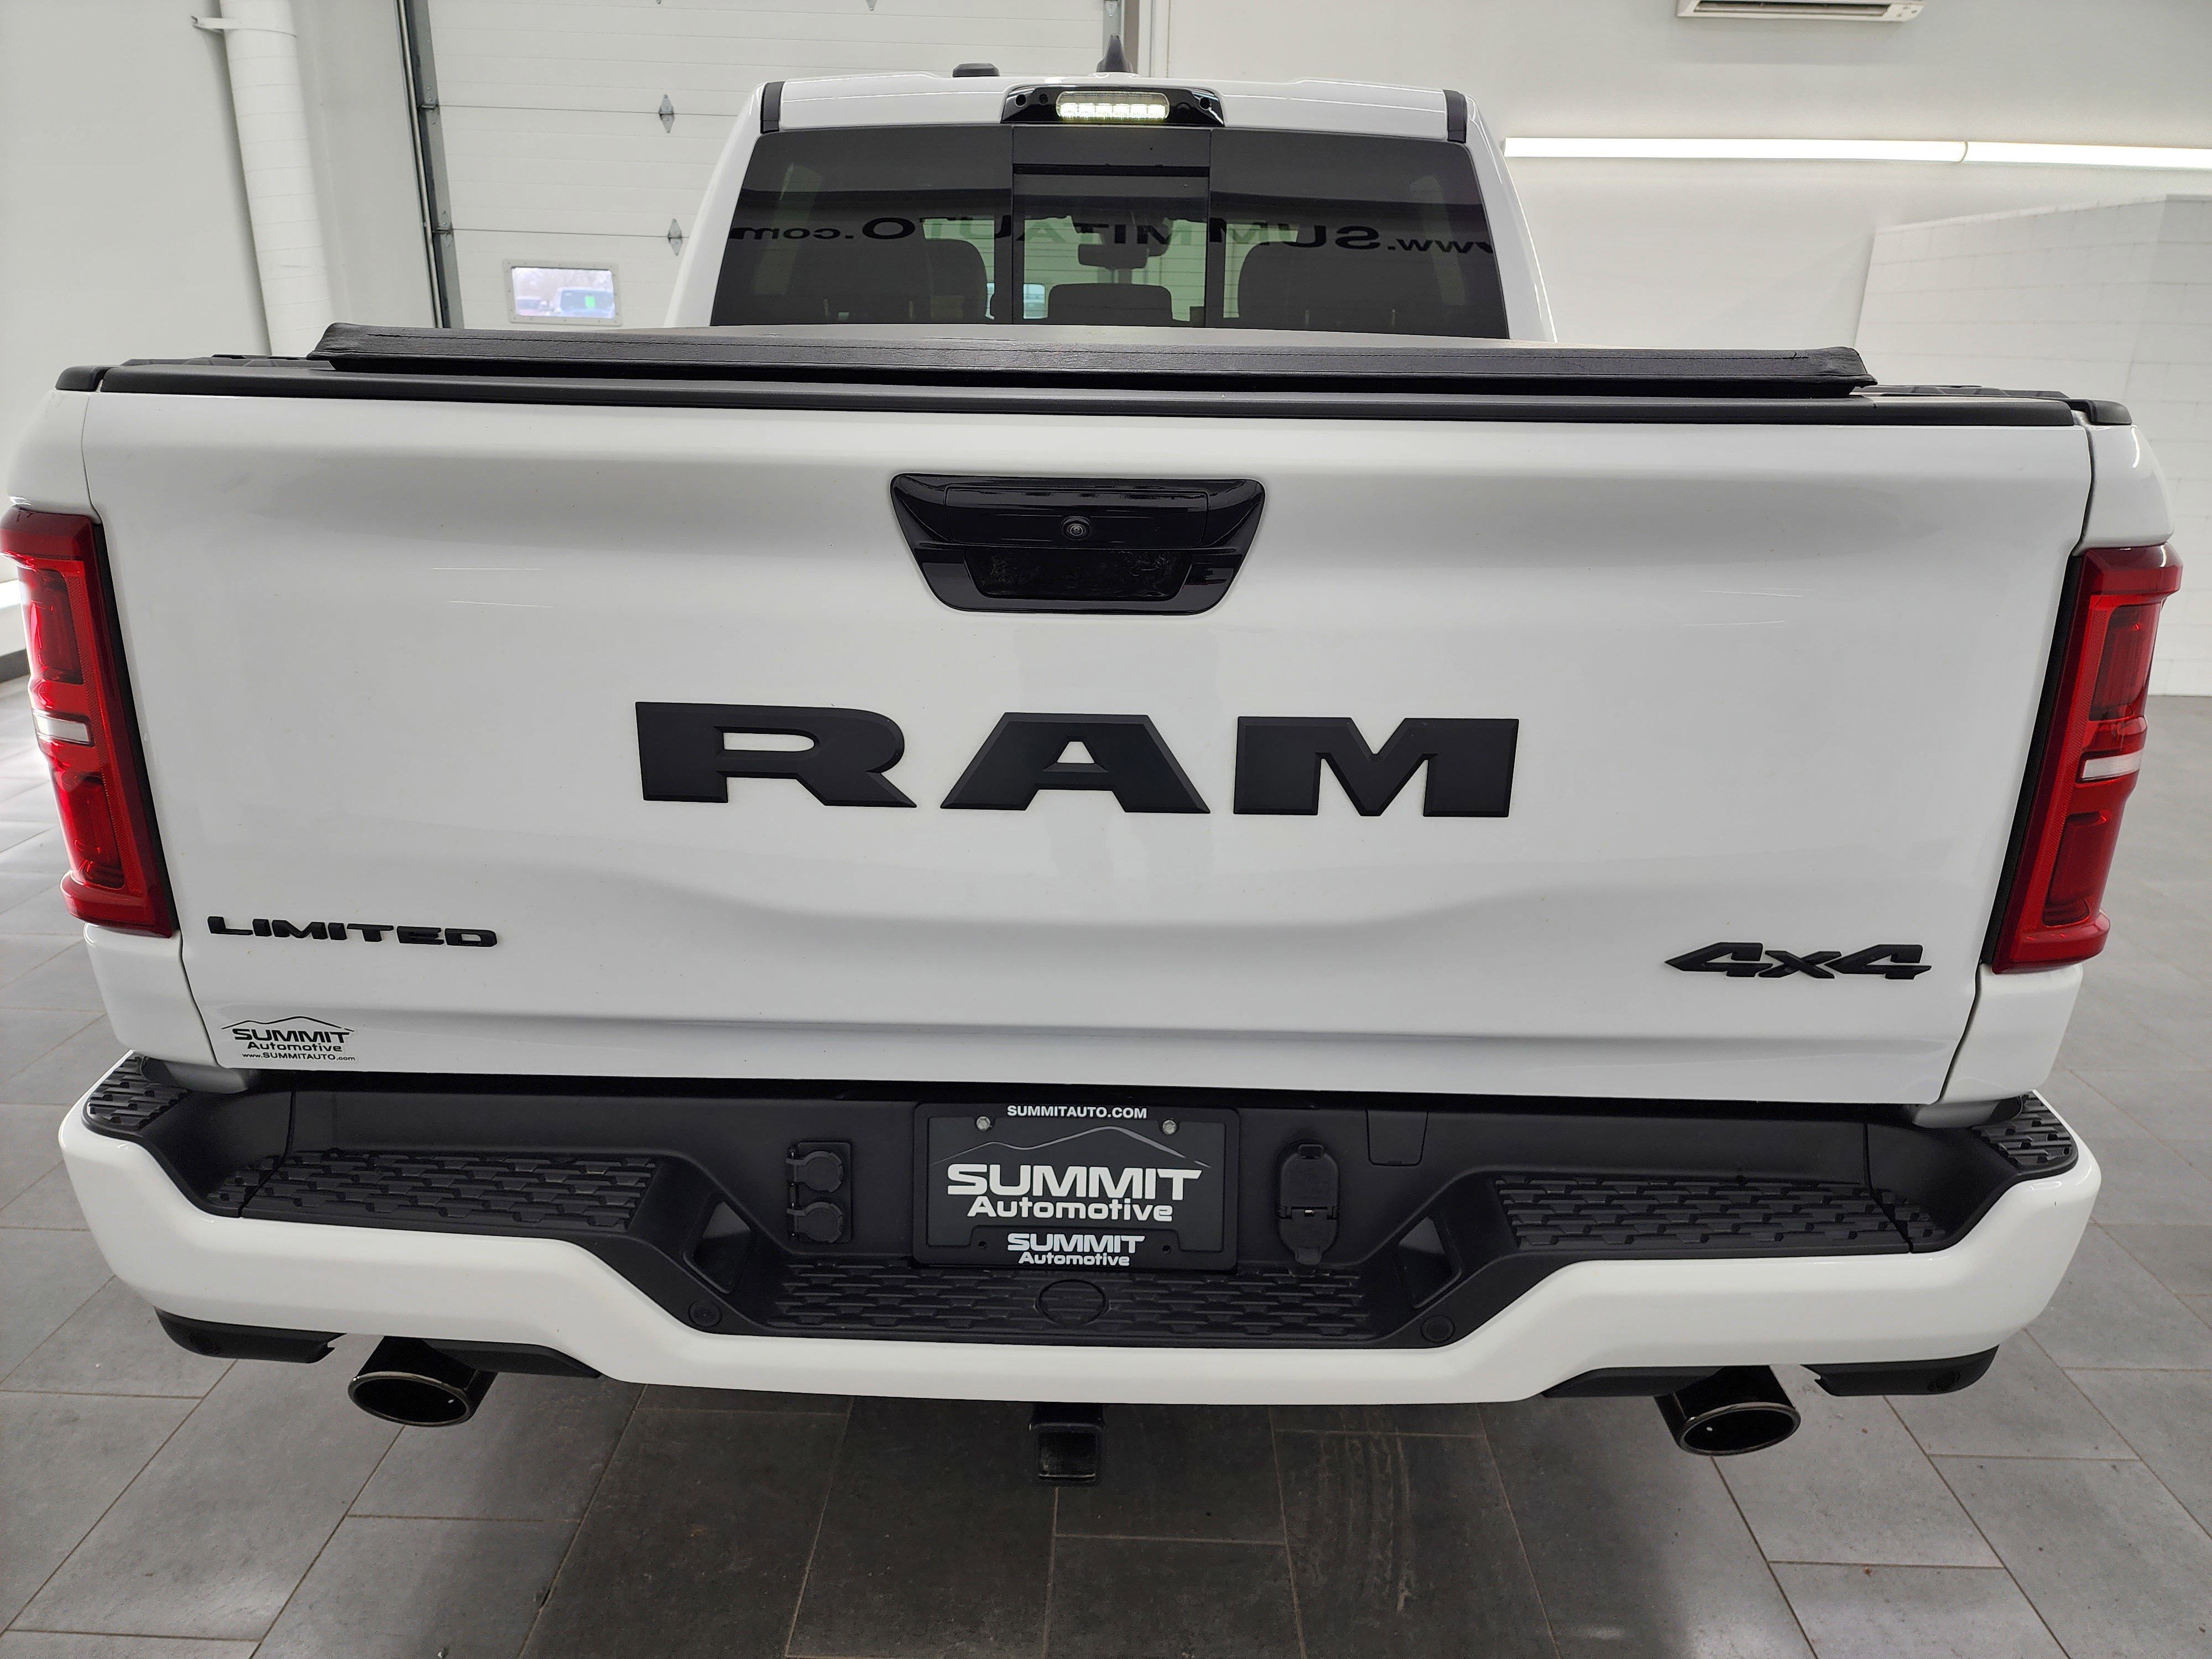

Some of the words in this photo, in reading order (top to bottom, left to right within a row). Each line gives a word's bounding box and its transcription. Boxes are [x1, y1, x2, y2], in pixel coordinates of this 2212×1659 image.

[635, 702, 1519, 817] RAM
[207, 916, 498, 947] LIMITED
[1664, 942, 1932, 980] 4x4
[232, 1028, 350, 1044] SUMMIT
[247, 1041, 342, 1052] Automotive
[242, 1052, 356, 1061] www.SUMMITAUTO.com
[1007, 1105, 1147, 1119] SUMMITAUTO.COM
[947, 1164, 1202, 1201] SUMMIT
[967, 1196, 1173, 1222] Automotive
[1007, 1233, 1145, 1254] SUMMIT
[1018, 1251, 1130, 1266] Automotive
